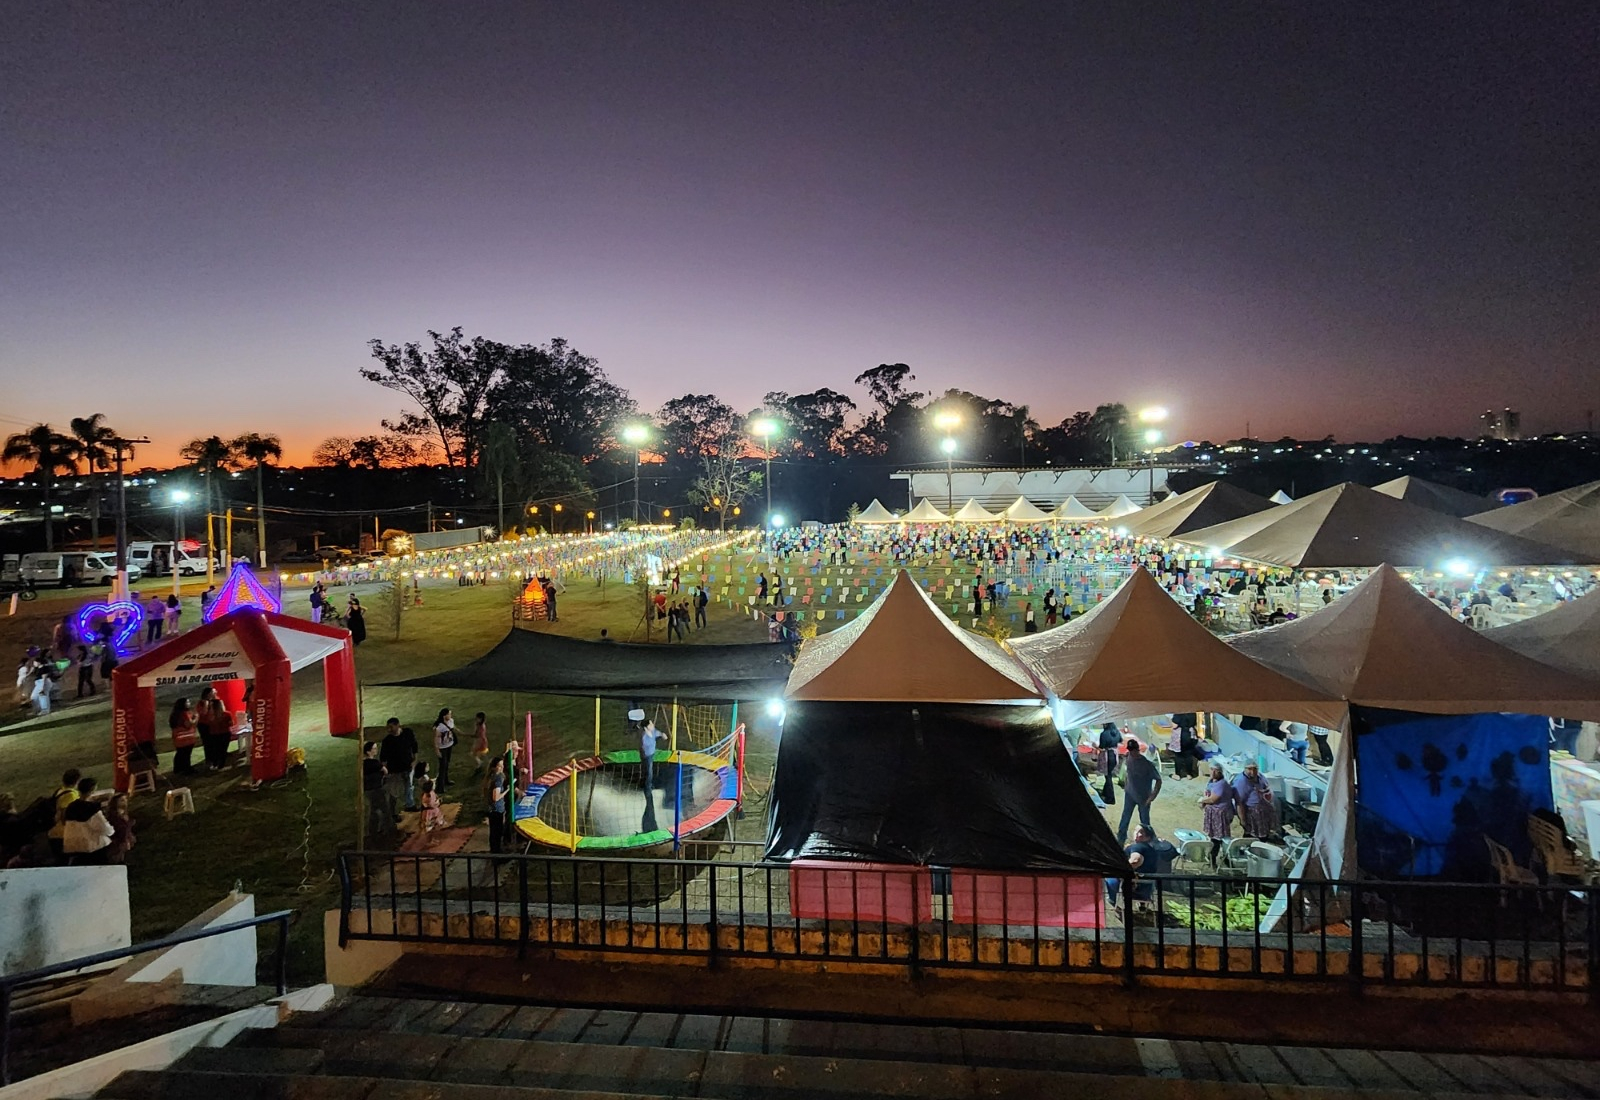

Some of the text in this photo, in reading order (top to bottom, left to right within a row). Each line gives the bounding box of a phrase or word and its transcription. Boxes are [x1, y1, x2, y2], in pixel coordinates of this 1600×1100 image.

[183, 651, 239, 660] PACAEMBU
[156, 676, 176, 686] SAIA
[189, 674, 201, 683] DO
[202, 671, 239, 682] ALUGUEL
[116, 708, 127, 769] PACAEMBU
[255, 698, 266, 759] PACAEMBU
